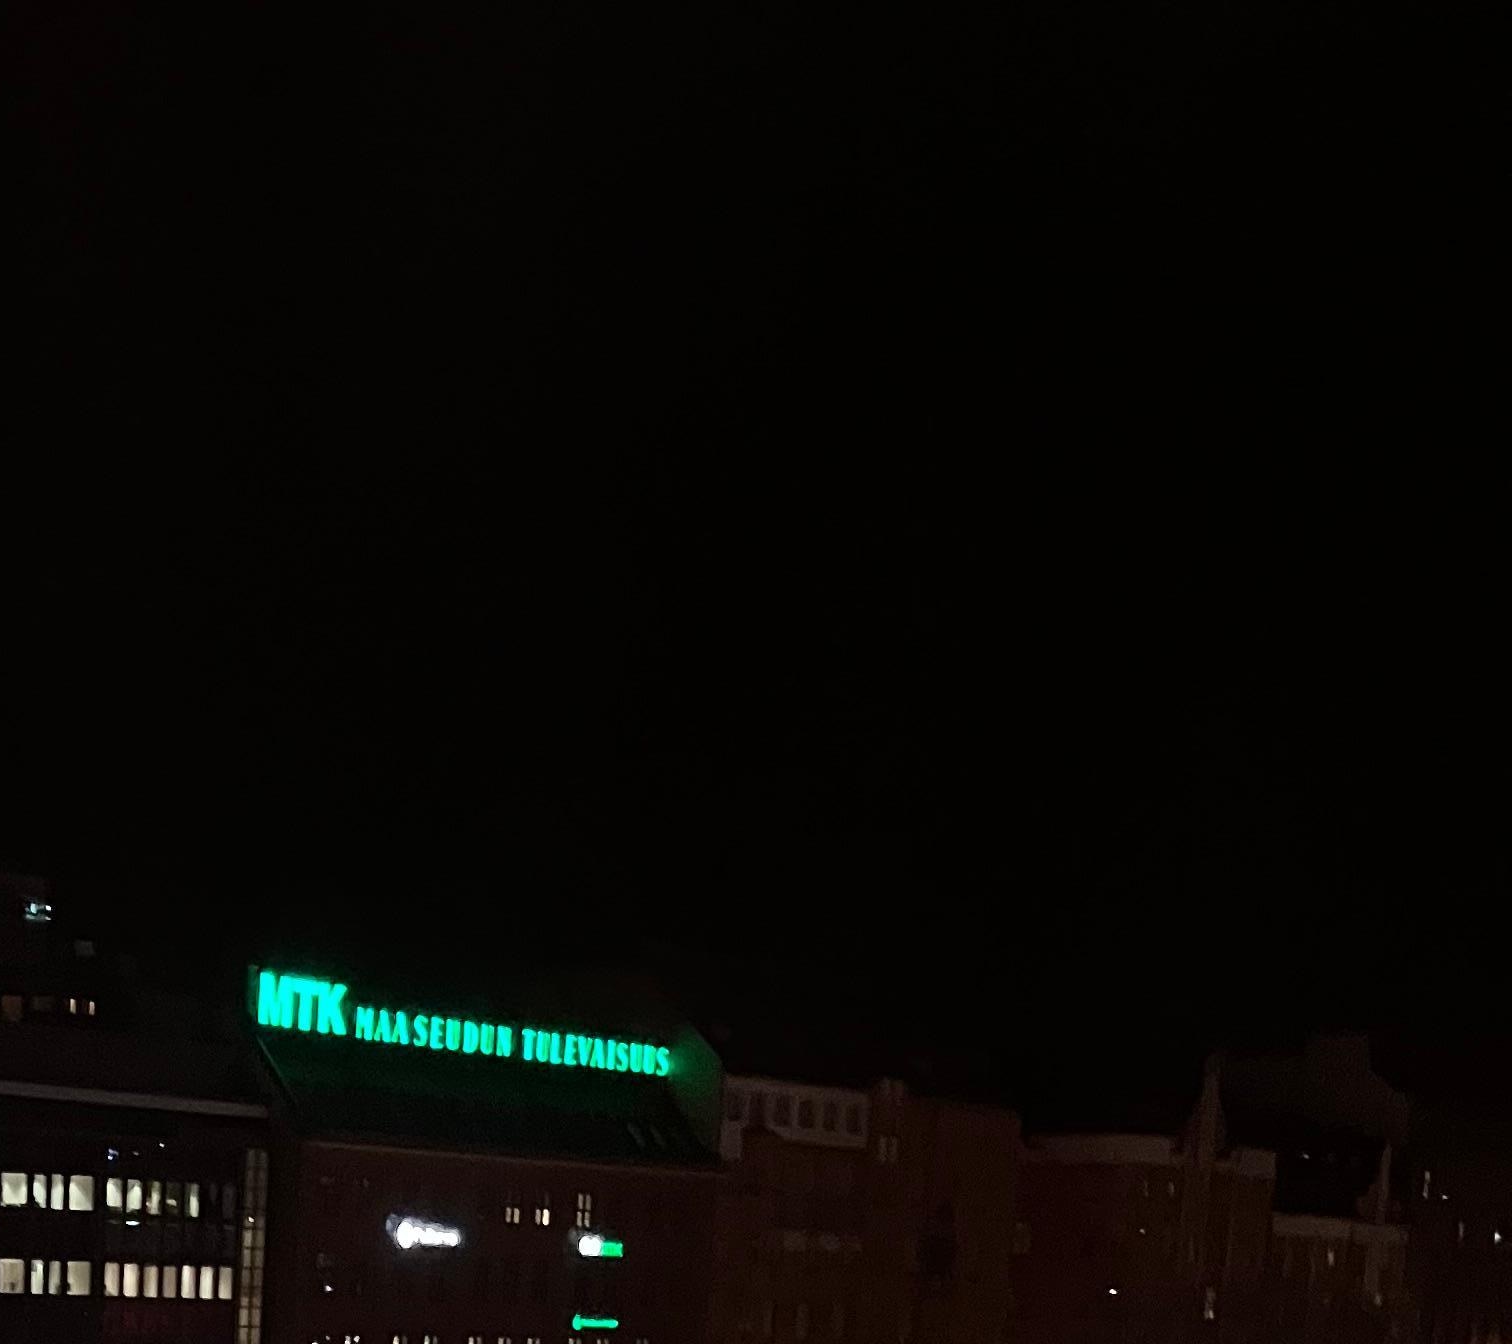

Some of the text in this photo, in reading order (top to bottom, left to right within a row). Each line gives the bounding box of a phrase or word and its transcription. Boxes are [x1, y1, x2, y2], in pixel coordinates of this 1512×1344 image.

[257, 971, 671, 1077] MTK MAASEUDUN TULEVAISUUS
